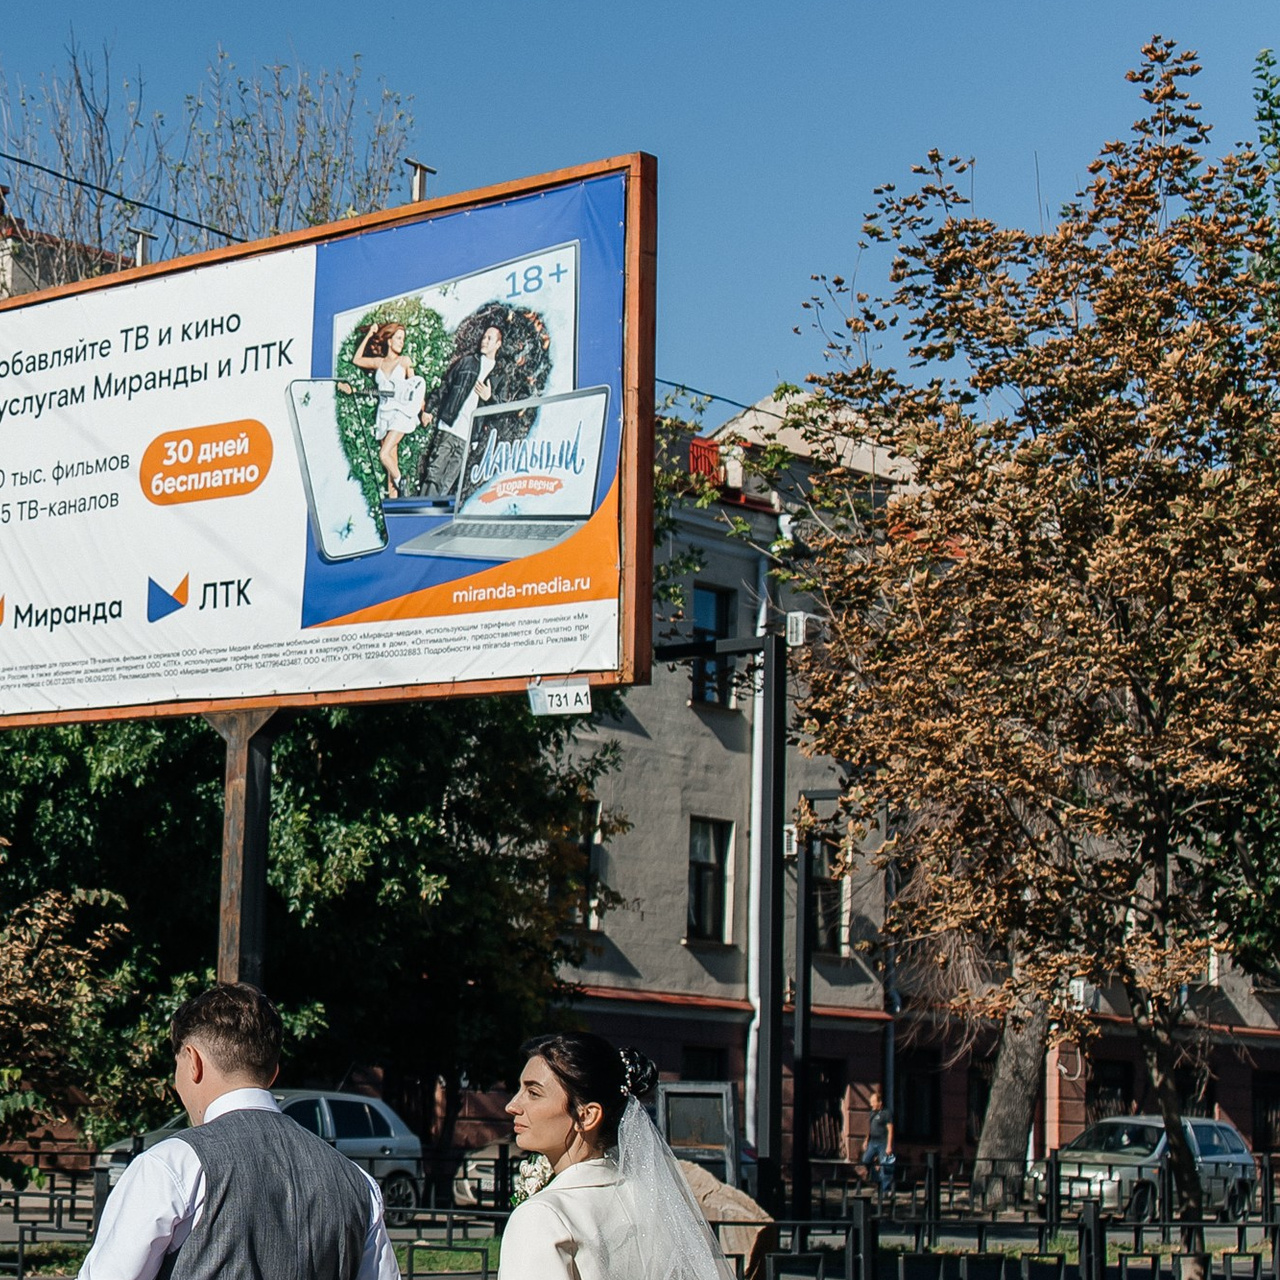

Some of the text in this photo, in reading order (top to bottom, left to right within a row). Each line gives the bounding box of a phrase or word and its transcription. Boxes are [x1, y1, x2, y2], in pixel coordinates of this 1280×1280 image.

[505, 262, 568, 298] 18+
[120, 325, 149, 353] ТВ
[158, 327, 171, 346] и
[181, 313, 241, 342] кино
[93, 361, 208, 400] Миранды
[218, 358, 231, 378] и
[240, 338, 295, 374] ЛТК
[162, 432, 249, 466] 30 дней
[11, 468, 46, 487] тыс.
[52, 454, 130, 485] фильмов
[151, 464, 260, 496] бесплатно
[17, 492, 119, 521] ТВ-каналов
[199, 578, 252, 610] ЛТК
[452, 576, 591, 603] miranda-media.ru
[14, 600, 122, 632] Миранда
[181, 648, 197, 656] ООО
[285, 637, 320, 646] мобильной
[425, 624, 478, 635] использующим
[480, 619, 516, 630] тарифные
[470, 630, 532, 641] предоставляется
[534, 625, 572, 634] бесплатно
[163, 668, 178, 676] ООО
[303, 656, 320, 664] ООО
[482, 638, 543, 650] miranda-media.ru
[545, 635, 577, 644] Реклама
[548, 693, 568, 707] 731
